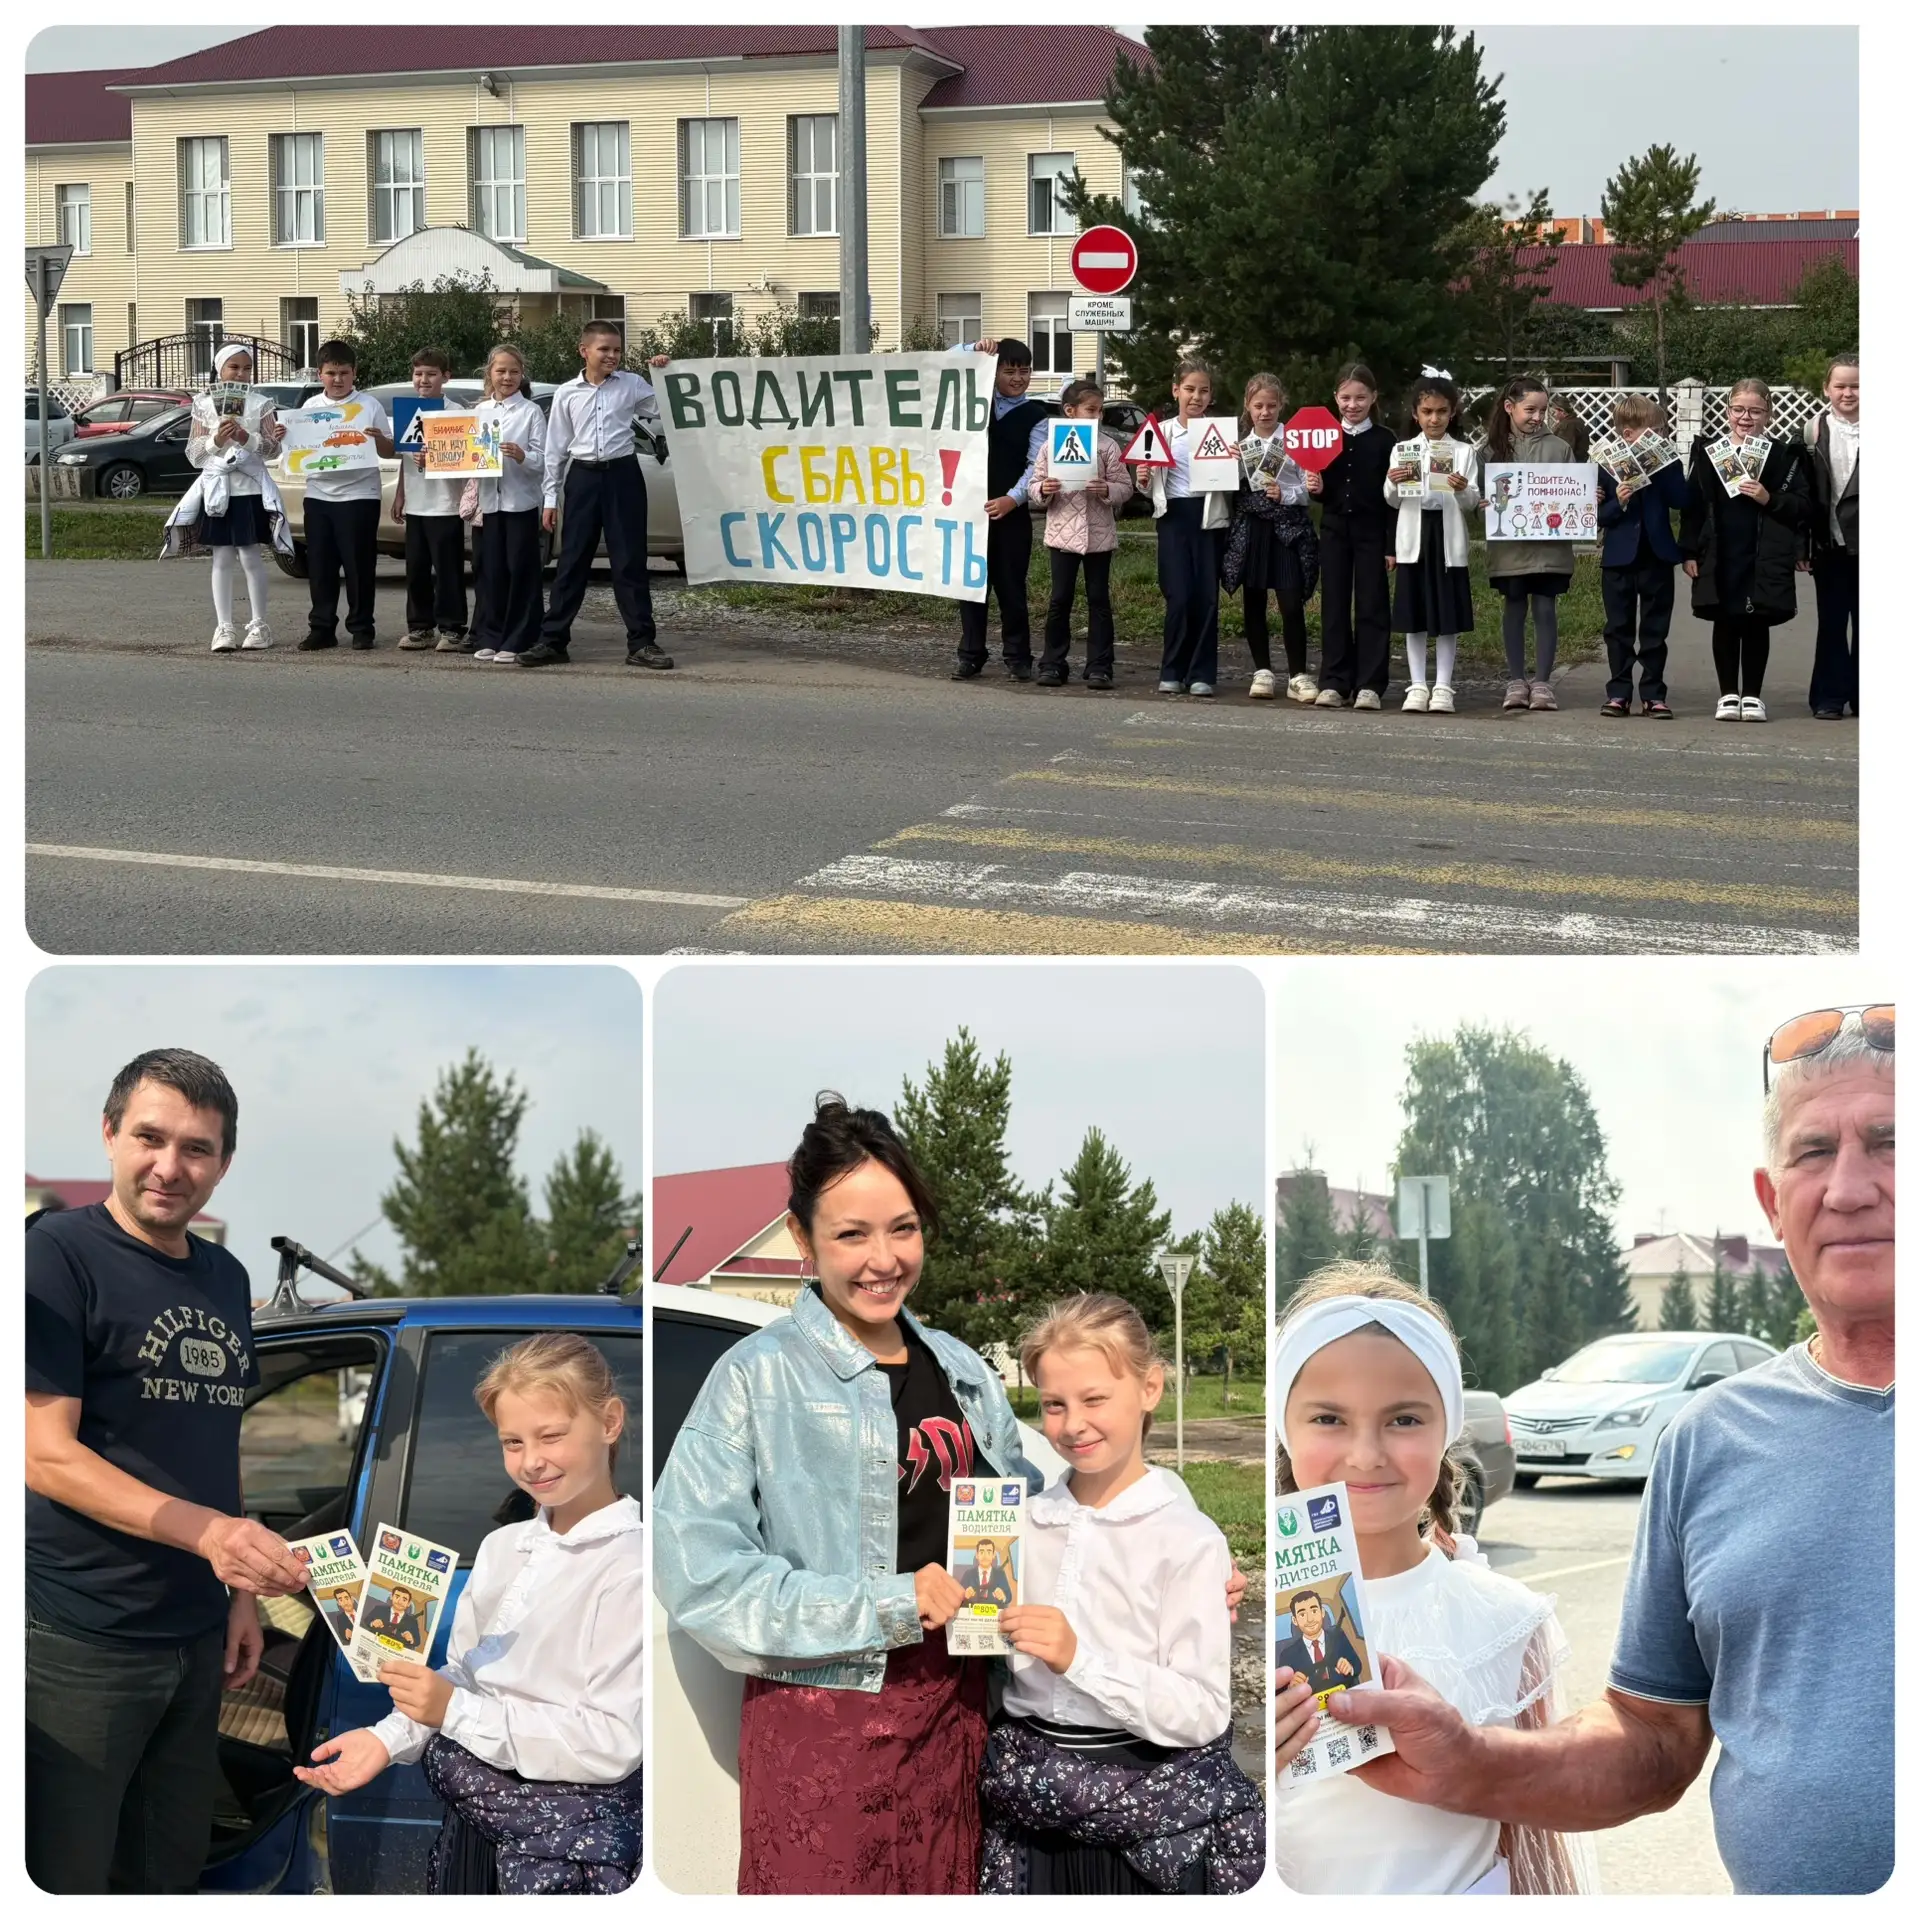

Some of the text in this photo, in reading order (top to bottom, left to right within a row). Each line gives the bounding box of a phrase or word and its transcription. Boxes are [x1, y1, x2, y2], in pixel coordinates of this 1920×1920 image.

[1074, 310, 1125, 318] СЛУЖЕБНЫХ
[664, 368, 989, 432] ВОДИТЕЛЬ
[427, 440, 448, 451] ДЕТИ
[1285, 428, 1340, 450] STOP
[429, 452, 435, 463] В
[761, 446, 925, 507] СБАВЬ
[1584, 516, 1594, 525] 50
[720, 512, 988, 589] СКОРОСТЬ
[137, 1305, 250, 1378] HILFIGER
[184, 1345, 220, 1368] 1985
[140, 1377, 200, 1403] NEW
[957, 1509, 1017, 1522] ПАМЯТКА
[962, 1524, 1012, 1534] водителя
[377, 1552, 440, 1586] ПАМЯТКА
[381, 1566, 433, 1592] водителя
